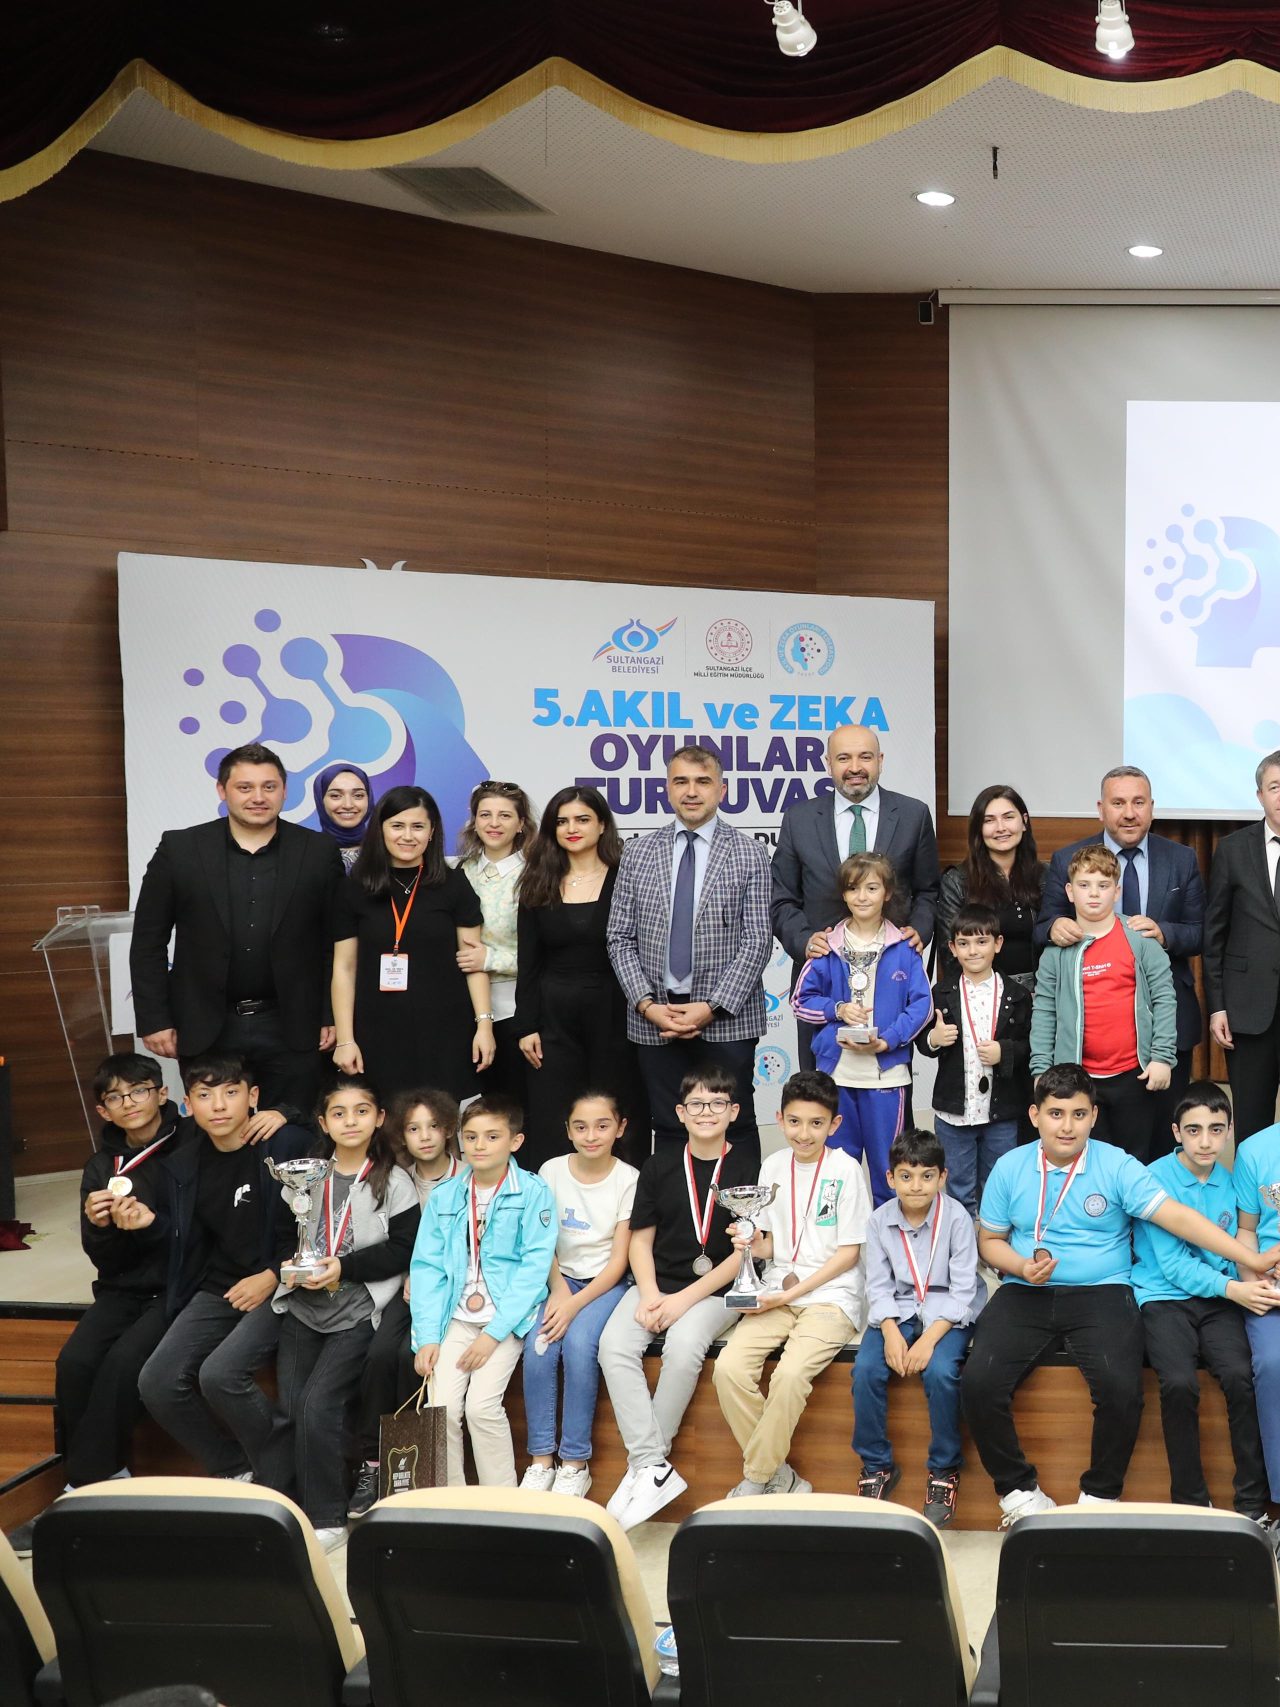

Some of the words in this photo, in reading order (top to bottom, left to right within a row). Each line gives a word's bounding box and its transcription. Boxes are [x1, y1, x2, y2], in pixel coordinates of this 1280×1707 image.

[606, 655, 664, 666] SULTANGAZİ
[611, 665, 660, 675] BELEDİYESİ
[532, 688, 694, 729] 5.AKIL
[704, 702, 760, 731] ve
[769, 694, 890, 732] ZEKA
